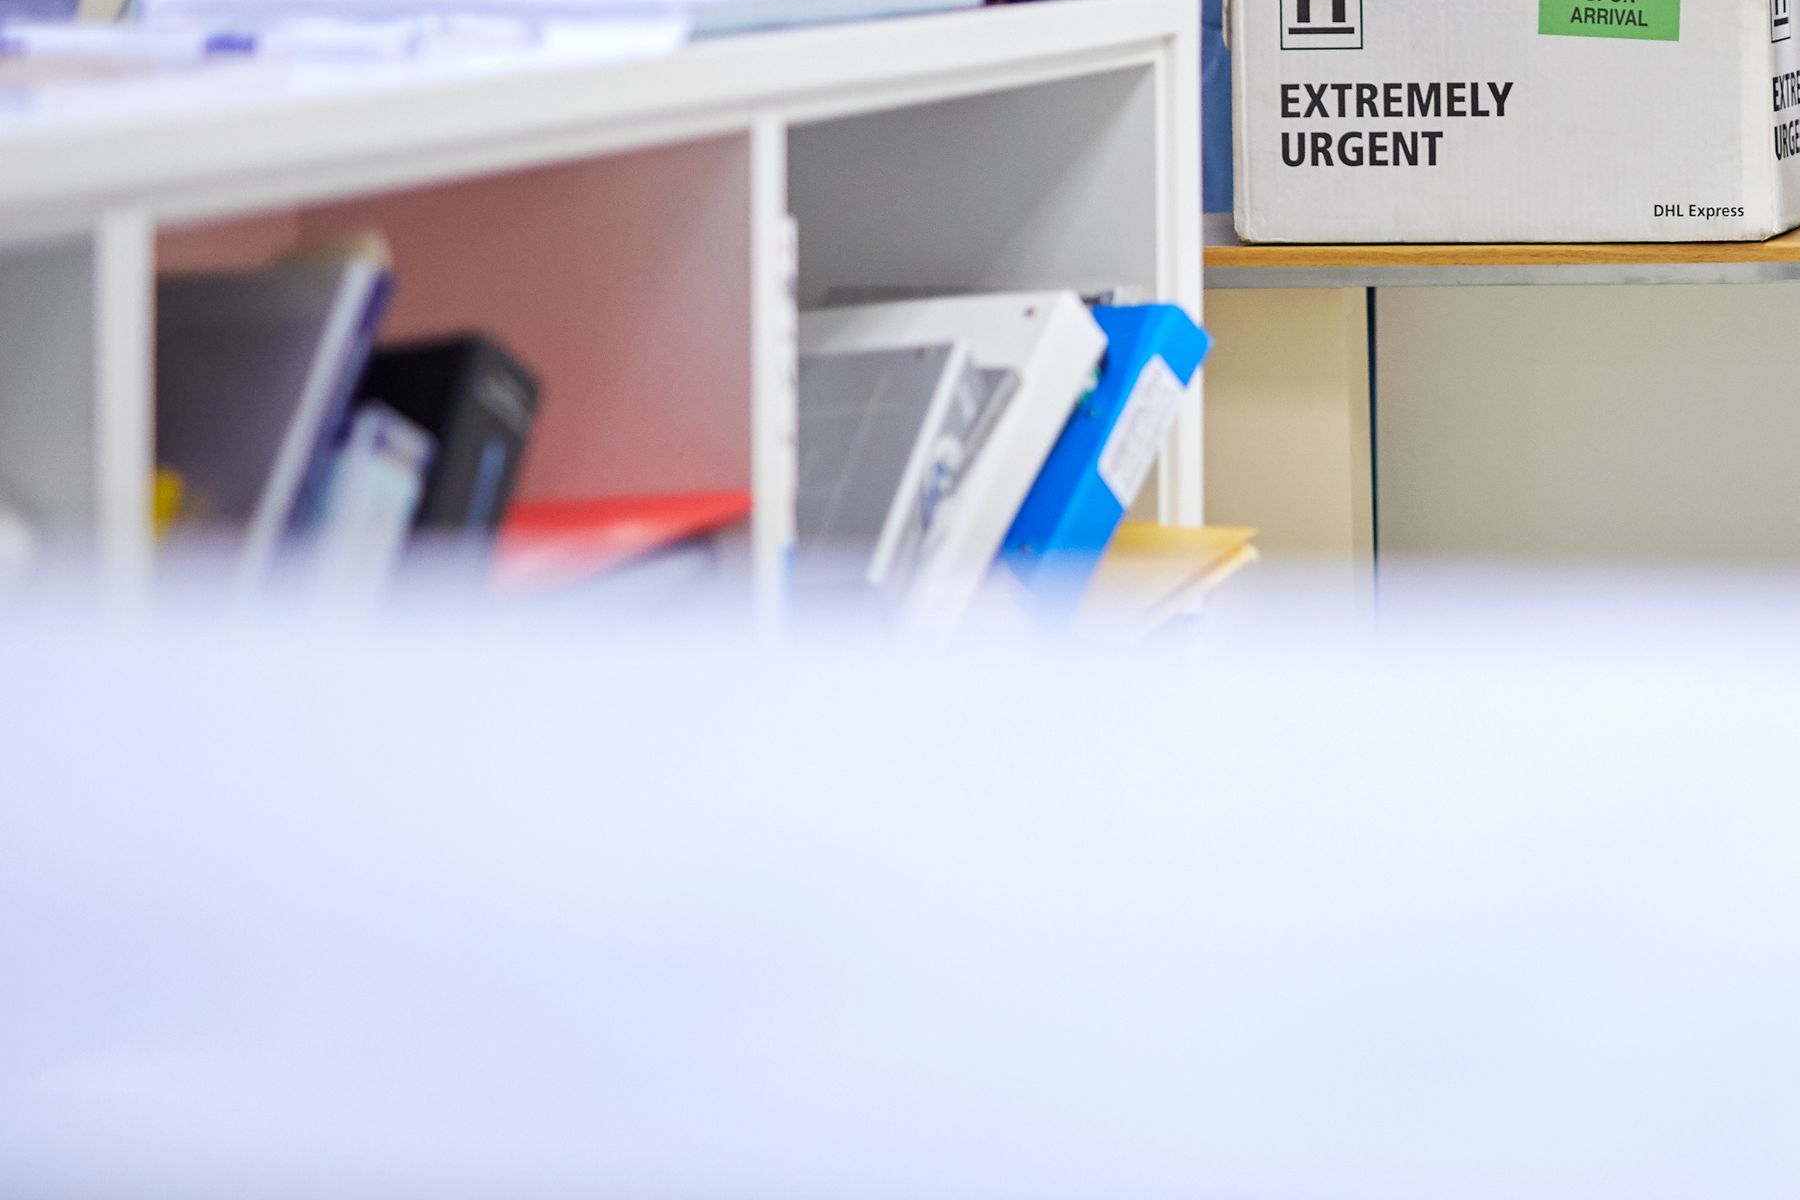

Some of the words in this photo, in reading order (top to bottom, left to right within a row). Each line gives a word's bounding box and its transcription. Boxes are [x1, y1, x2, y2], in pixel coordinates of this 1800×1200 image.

[1570, 6, 1649, 27] ARRIVAL
[1280, 82, 1514, 118] EXTREMELY
[1281, 131, 1444, 167] URGENT
[1653, 204, 1684, 217] DHL
[1688, 204, 1745, 220] Express
